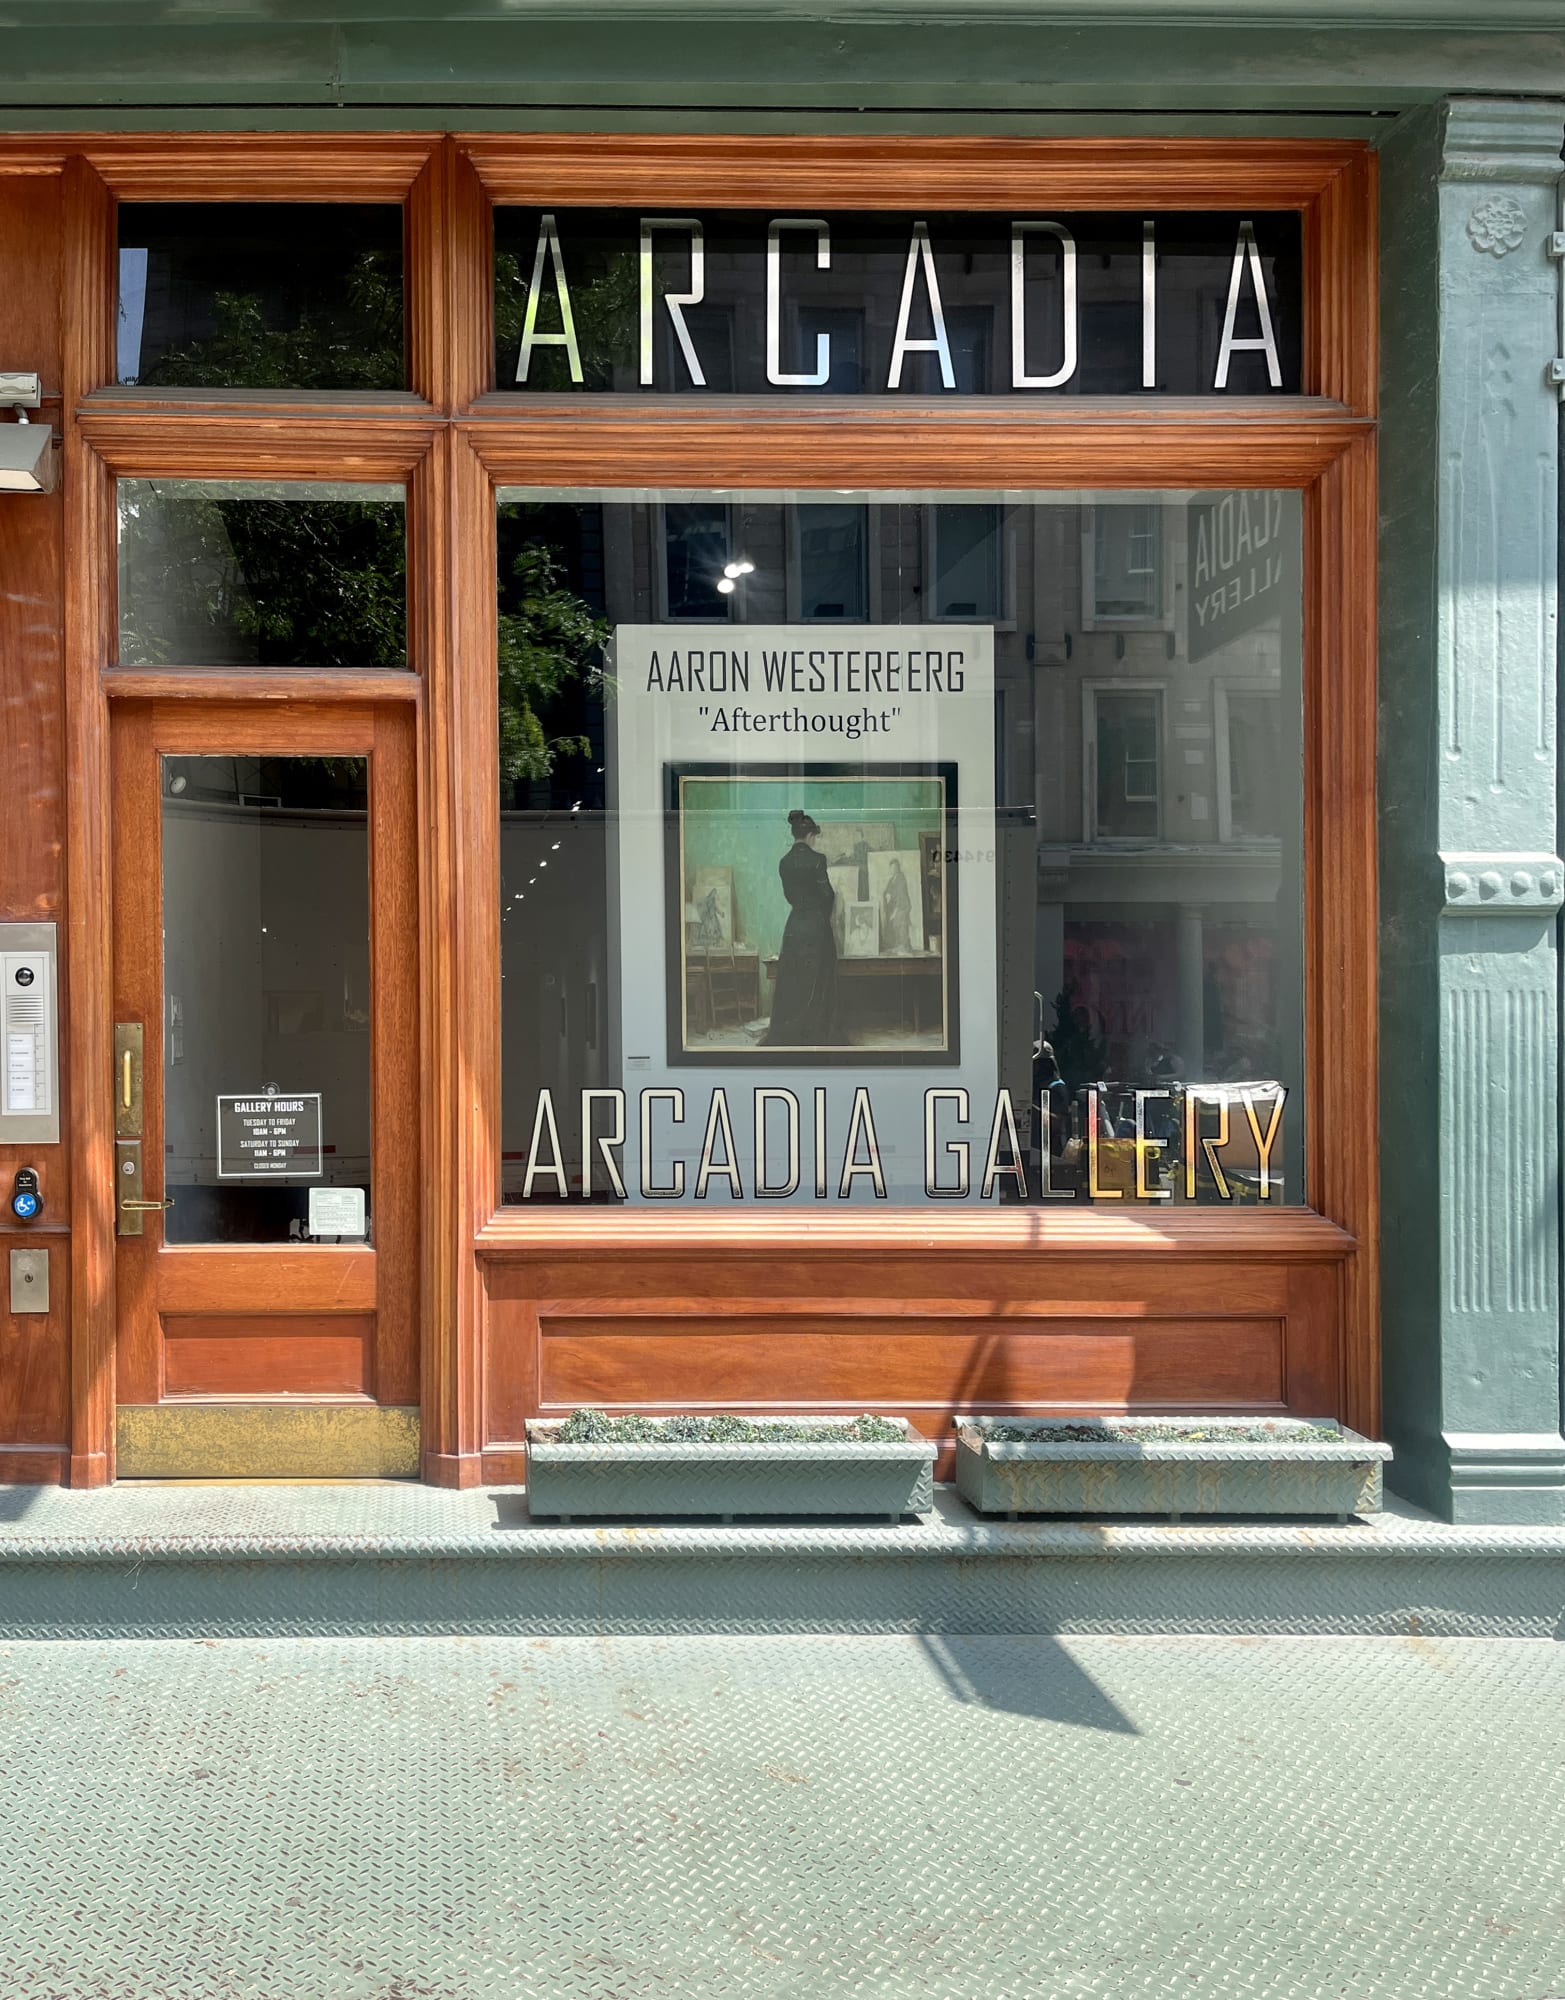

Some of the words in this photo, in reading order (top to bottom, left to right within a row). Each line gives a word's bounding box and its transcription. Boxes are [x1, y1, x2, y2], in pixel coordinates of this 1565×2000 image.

[515, 214, 1283, 390] ARCADIA
[646, 650, 749, 692] AARON
[762, 650, 964, 693] WESTERBERG
[698, 706, 902, 740] "Afterthought"
[234, 1102, 272, 1113] GALLERY
[274, 1101, 304, 1112] HOURS
[243, 1118, 267, 1126] TUESDAY
[268, 1118, 276, 1126] TO
[276, 1118, 296, 1126] FRIDAY
[240, 1140, 268, 1148] SATURDAY
[277, 1139, 300, 1147] SUNDAY
[521, 1087, 888, 1200] ARCADIA
[923, 1087, 1290, 1201] GALLERY
